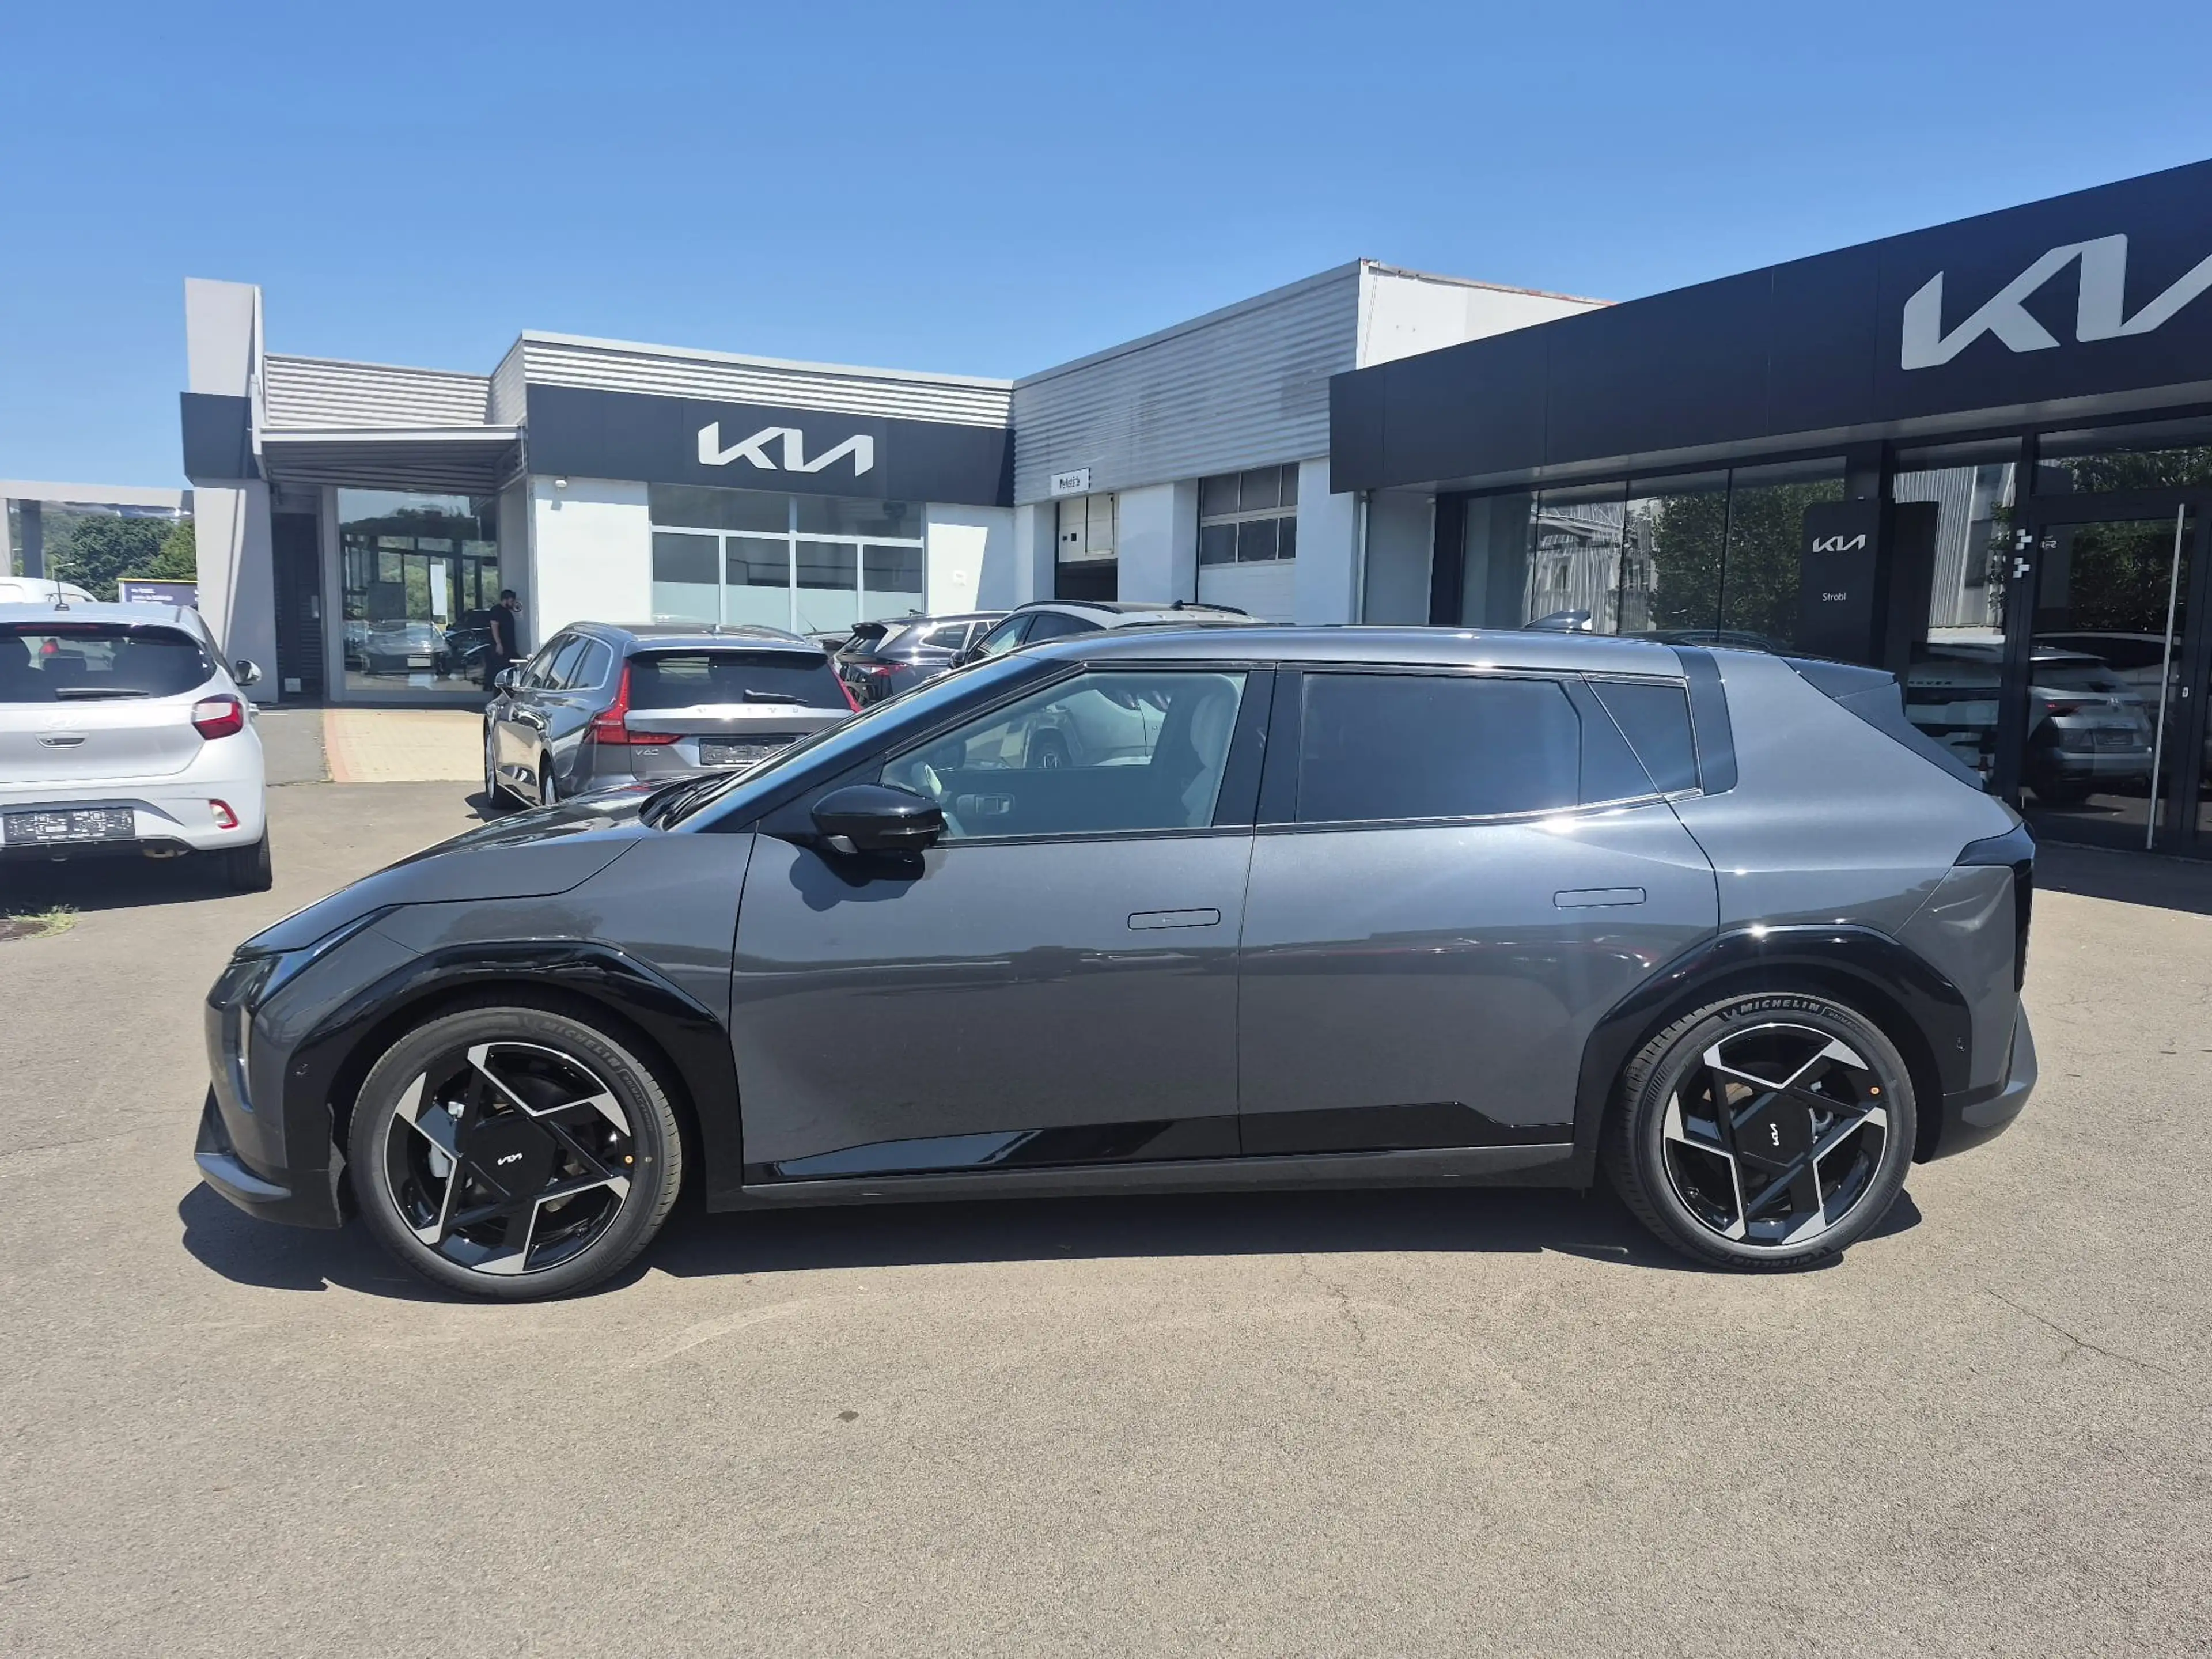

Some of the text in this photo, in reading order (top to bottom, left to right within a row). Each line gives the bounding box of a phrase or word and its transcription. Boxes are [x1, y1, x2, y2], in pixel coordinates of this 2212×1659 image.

[698, 421, 874, 477] KIA
[1812, 533, 1866, 552] KIA
[1823, 592, 1847, 601] Strobl
[1741, 999, 1820, 1013] MICHELIN
[540, 1020, 620, 1070] MICHELIN
[497, 1152, 523, 1165] KIA
